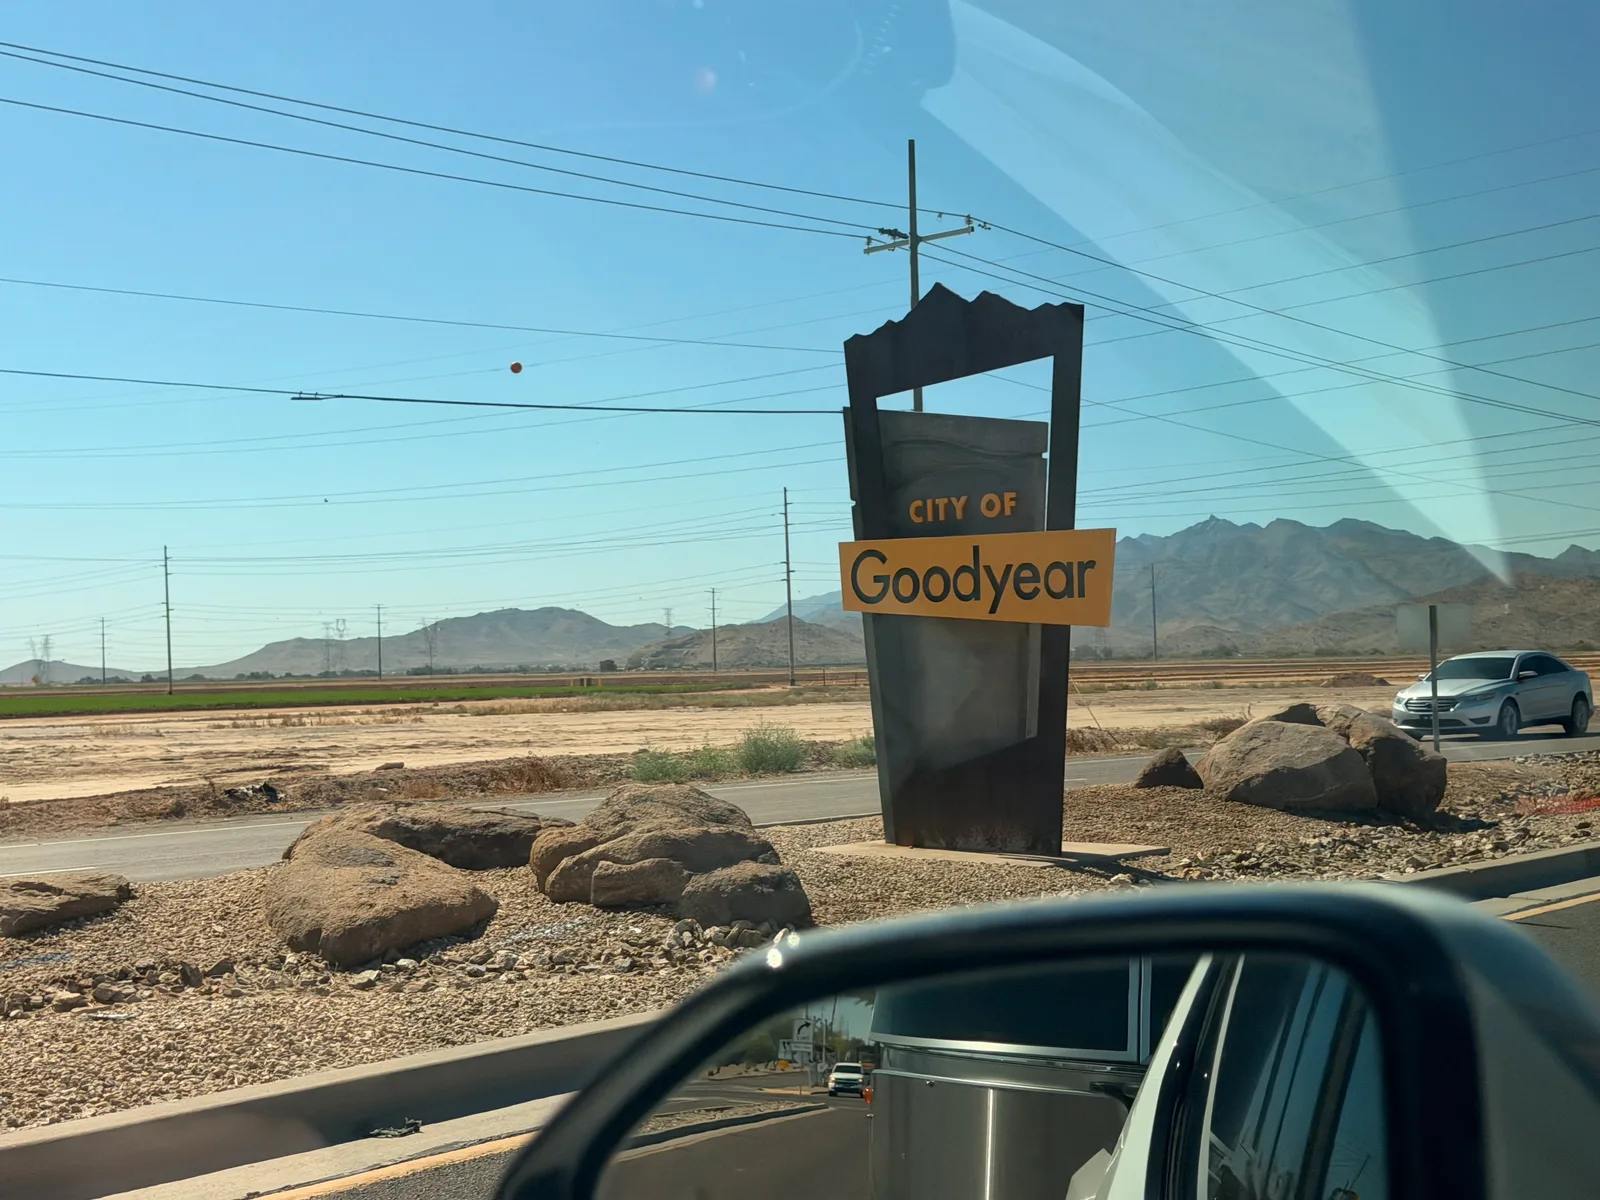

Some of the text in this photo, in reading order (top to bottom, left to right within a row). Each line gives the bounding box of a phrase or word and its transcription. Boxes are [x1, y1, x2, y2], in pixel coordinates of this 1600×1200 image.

[909, 491, 1017, 523] CITY OF
[851, 545, 1096, 614] Goodyear
